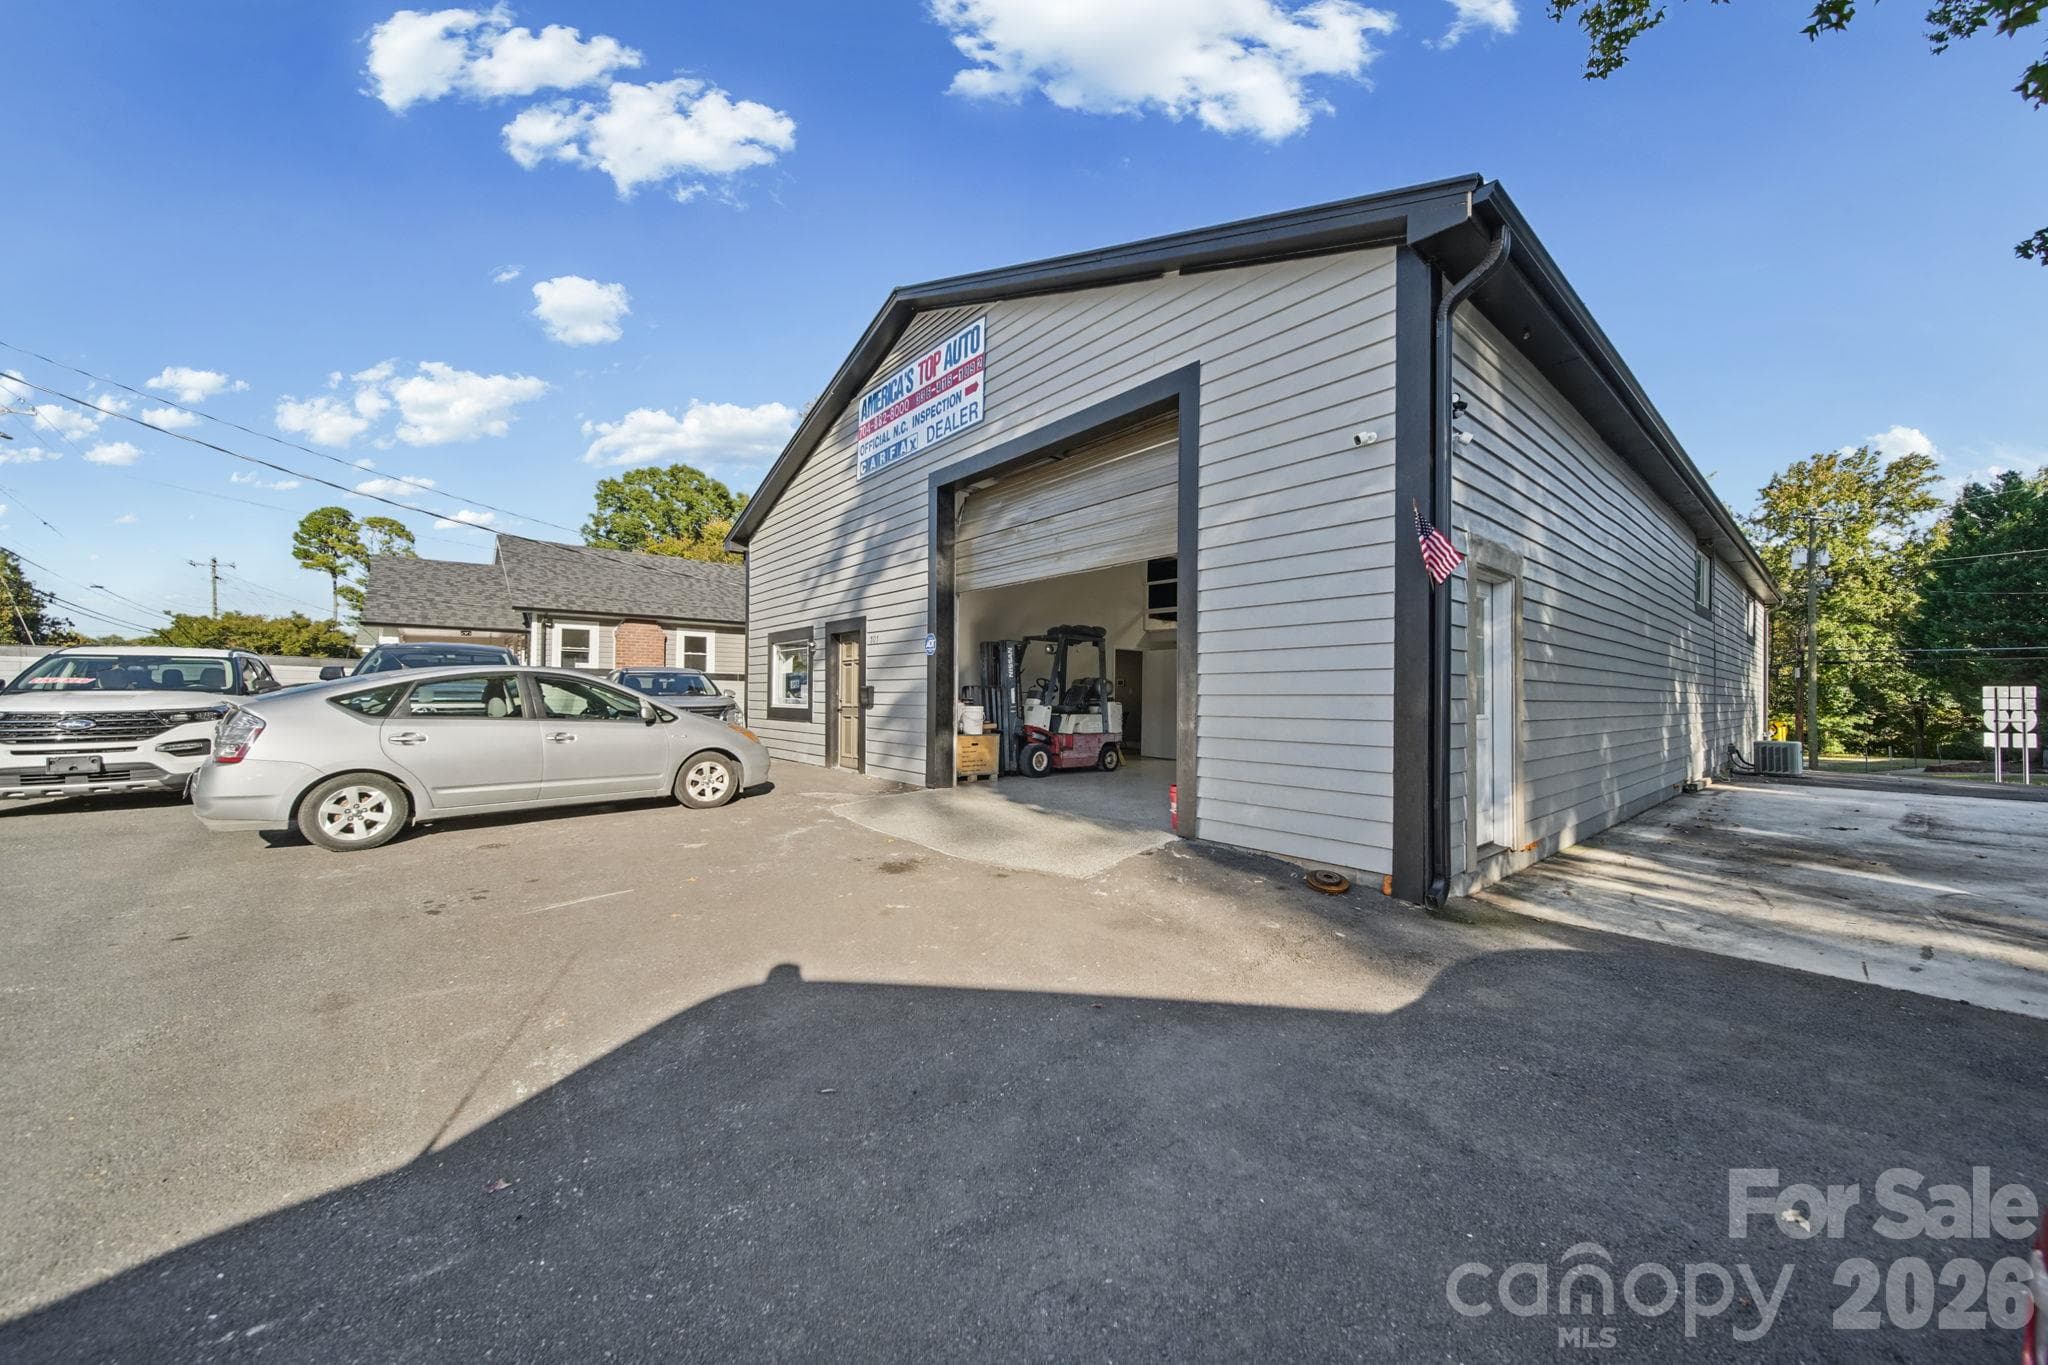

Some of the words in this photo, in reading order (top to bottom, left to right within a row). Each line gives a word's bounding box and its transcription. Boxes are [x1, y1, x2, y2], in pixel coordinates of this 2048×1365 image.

[861, 367, 914, 421] AMERICA'S
[918, 350, 942, 386] TOP
[944, 324, 981, 371] AUTO
[860, 430, 890, 456] OFFICIAL
[893, 421, 909, 438] N.C.
[912, 390, 962, 428] INSPECTION
[860, 436, 917, 475] CARFAX
[926, 401, 979, 444] DEALER
